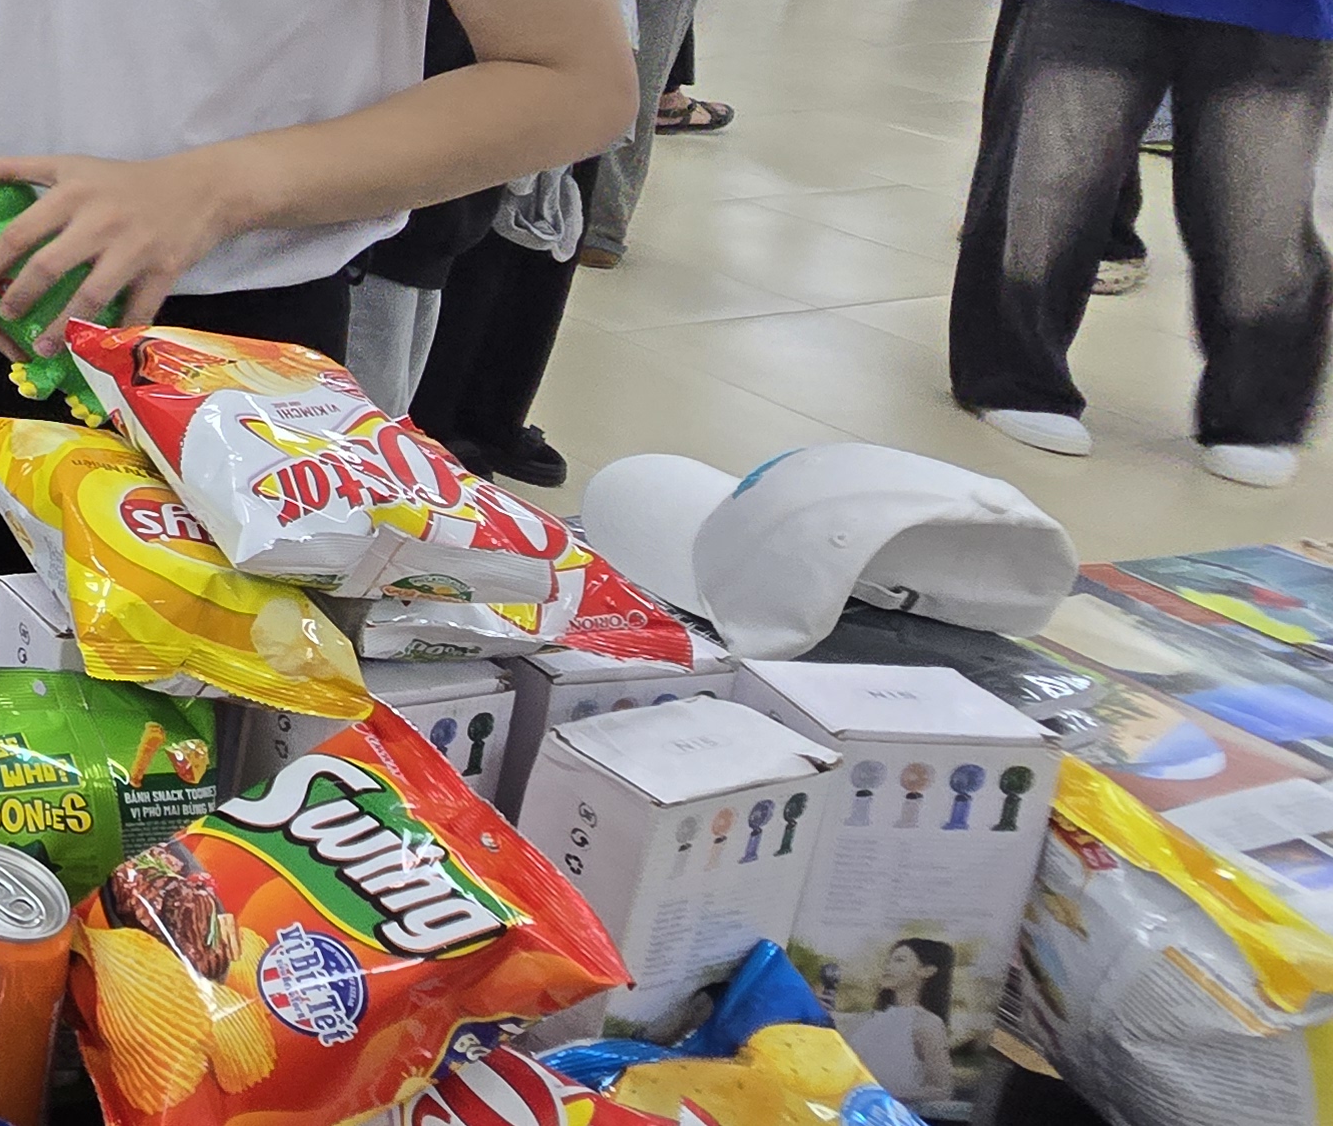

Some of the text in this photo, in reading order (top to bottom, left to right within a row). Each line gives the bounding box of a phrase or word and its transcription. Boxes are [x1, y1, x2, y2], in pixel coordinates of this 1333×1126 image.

[276, 404, 328, 421] KIMCHI
[567, 615, 622, 632] ORION
[0, 758, 69, 788] WHO?
[124, 788, 151, 804] BÁNH
[152, 788, 184, 802] SNACK
[163, 805, 180, 816] MAI
[218, 752, 511, 961] Swing
